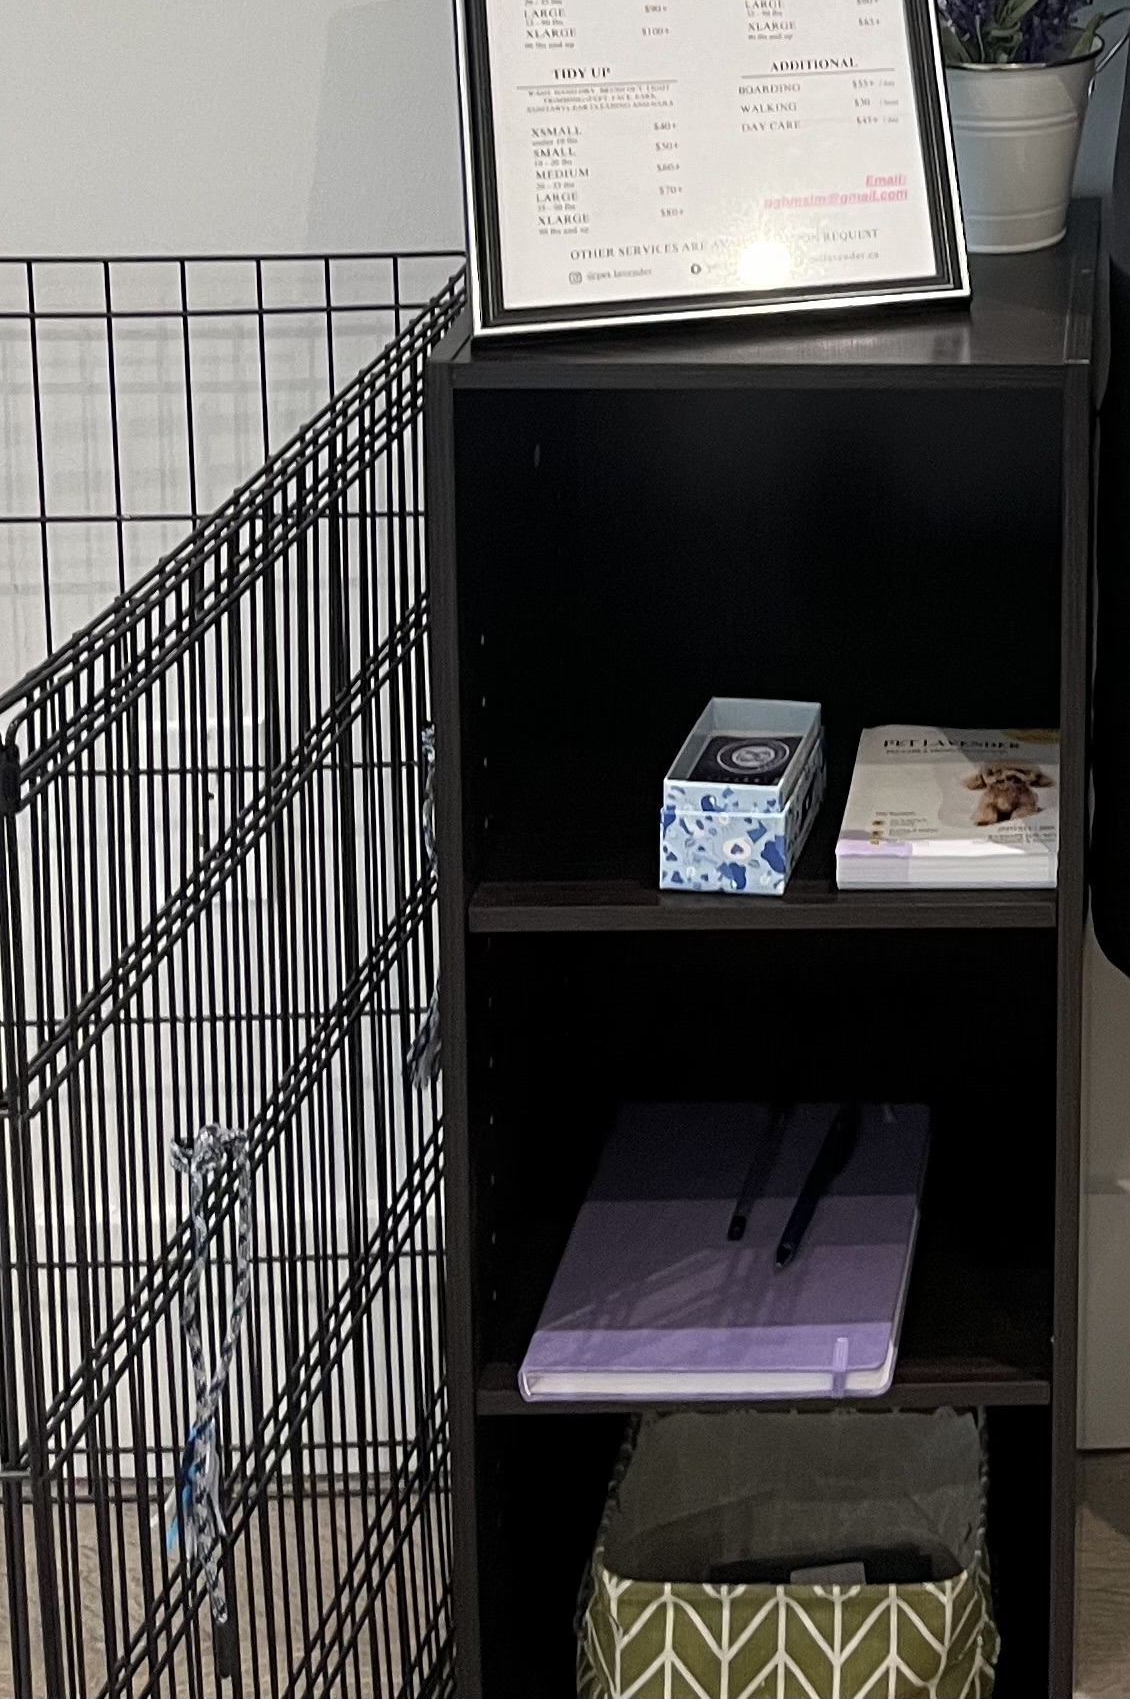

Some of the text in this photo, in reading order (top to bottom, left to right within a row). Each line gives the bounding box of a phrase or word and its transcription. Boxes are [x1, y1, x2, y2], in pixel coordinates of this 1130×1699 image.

[744, 0, 784, 10] LARGE
[523, 7, 567, 19] LARGE
[747, 20, 797, 32] XLARGE
[525, 26, 577, 39] XLARGE
[770, 57, 858, 72] ADDITIONAL
[553, 66, 612, 80] TIDY UP
[738, 83, 801, 95] BOARDING
[740, 101, 797, 113] WALKING
[531, 126, 582, 138] XSMALL
[742, 120, 802, 132] DAY CARE
[533, 147, 577, 158] SMALL
[535, 168, 589, 180] MEDIUM
[865, 172, 907, 188] Email:
[536, 191, 578, 203] LARGE
[537, 213, 591, 226] XLARGE
[570, 248, 615, 260] OTHER
[618, 243, 679, 257] SERVICES
[681, 241, 705, 252] ARE
[823, 228, 879, 242] REQUEST
[883, 739, 1020, 750] PET LAVENDER
